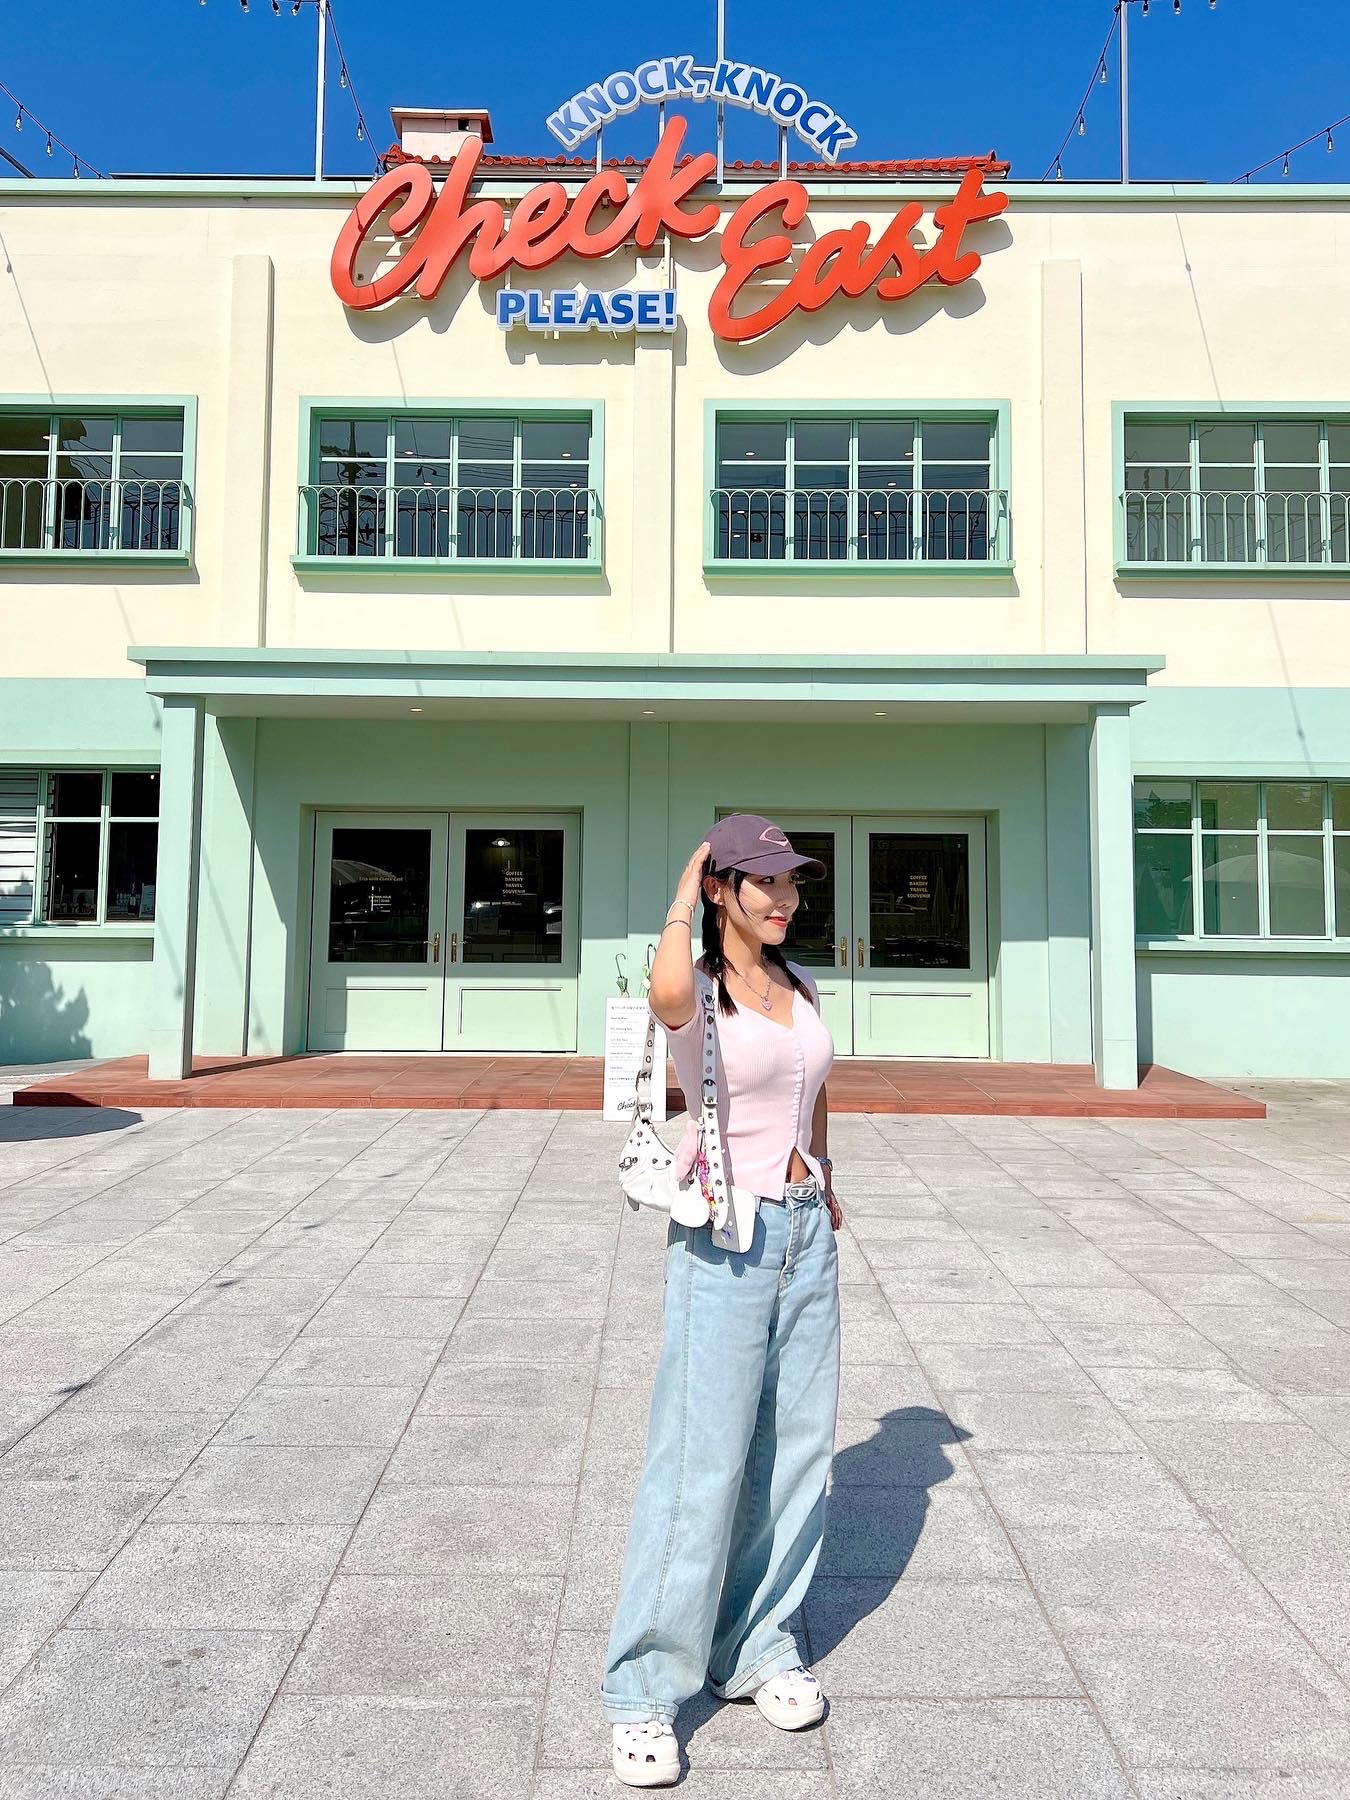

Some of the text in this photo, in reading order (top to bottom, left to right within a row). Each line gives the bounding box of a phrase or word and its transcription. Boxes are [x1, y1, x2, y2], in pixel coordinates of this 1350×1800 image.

[548, 57, 855, 158] KNOCK, KNOCK
[331, 115, 1009, 342] Check East
[499, 292, 675, 325] PLEASE!
